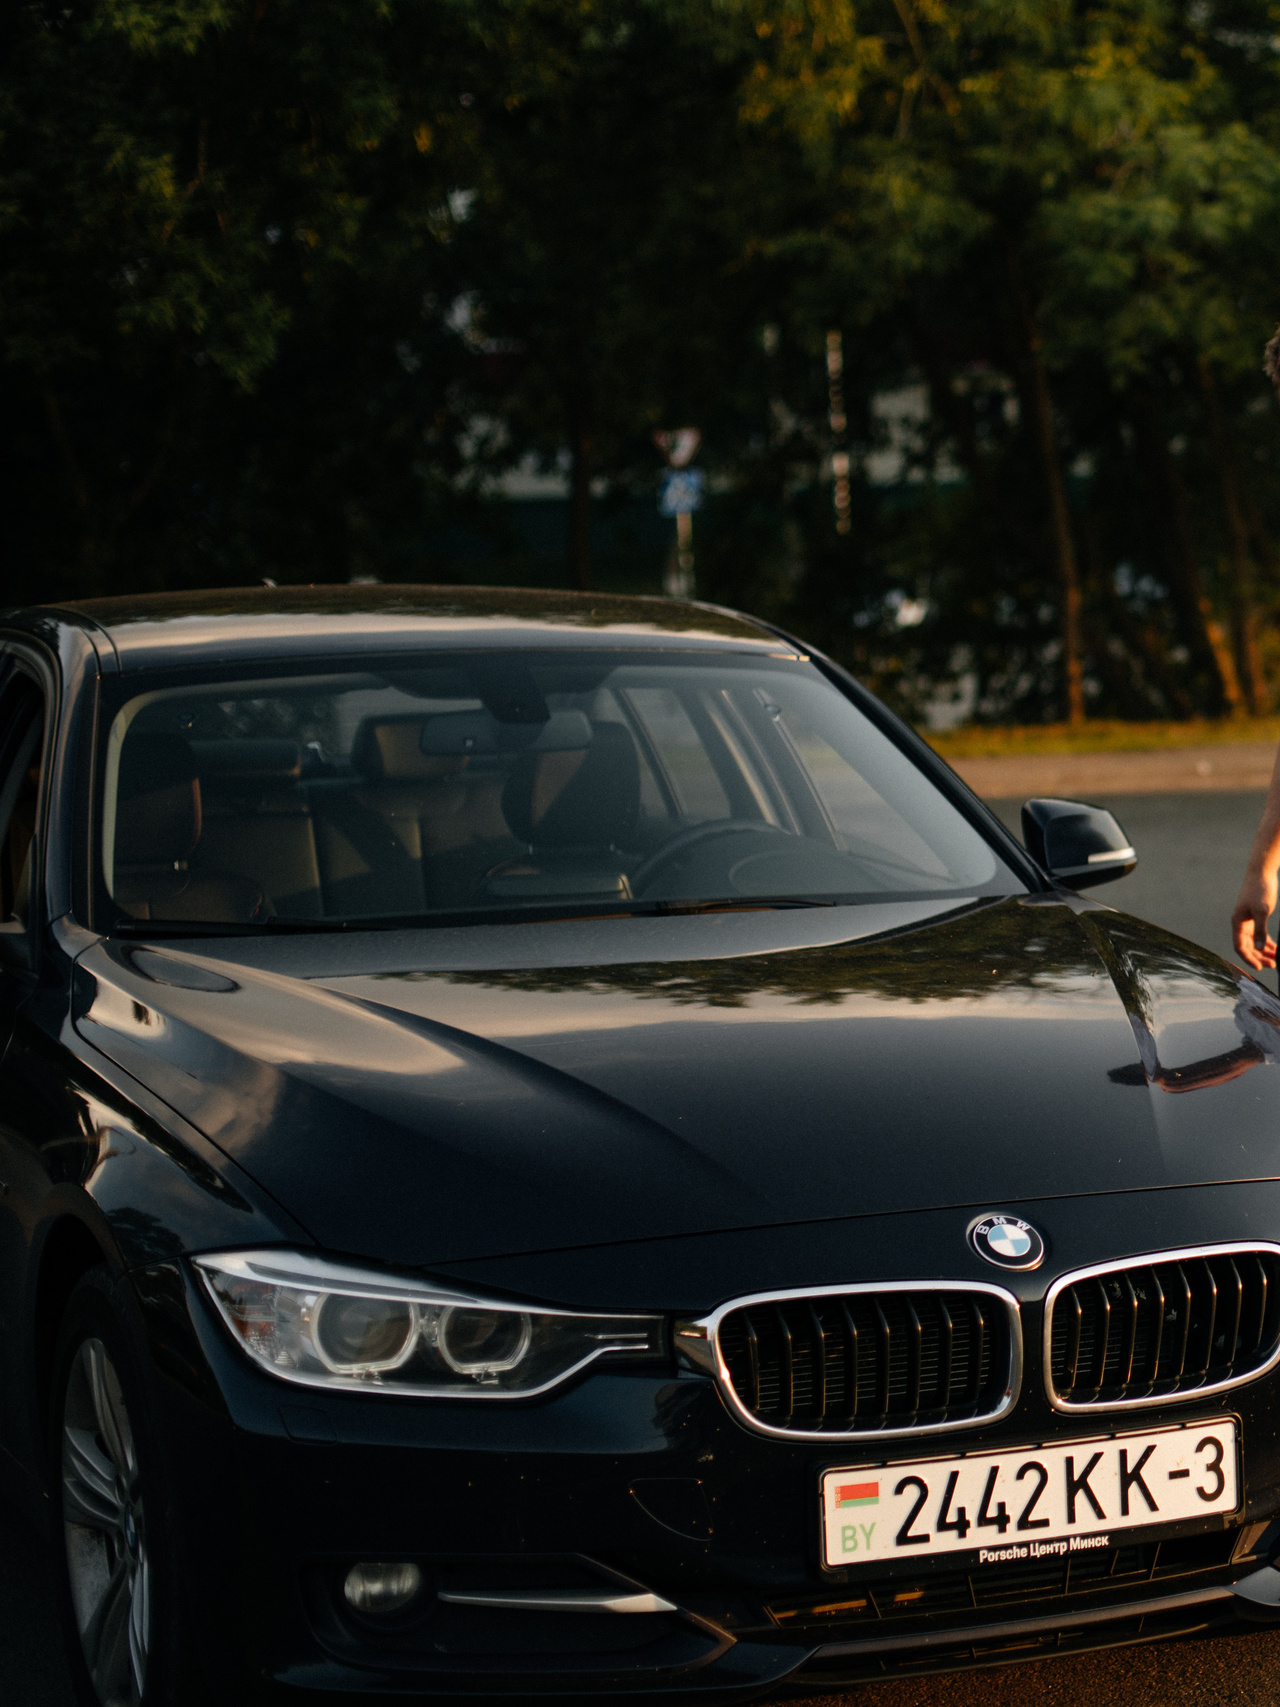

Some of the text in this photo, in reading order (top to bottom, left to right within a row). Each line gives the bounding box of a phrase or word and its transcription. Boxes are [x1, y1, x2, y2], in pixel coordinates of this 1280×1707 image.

[977, 1216, 1031, 1235] BMW
[841, 1522, 877, 1553] BY
[979, 1535, 1109, 1563] Porsche Центр Минск
